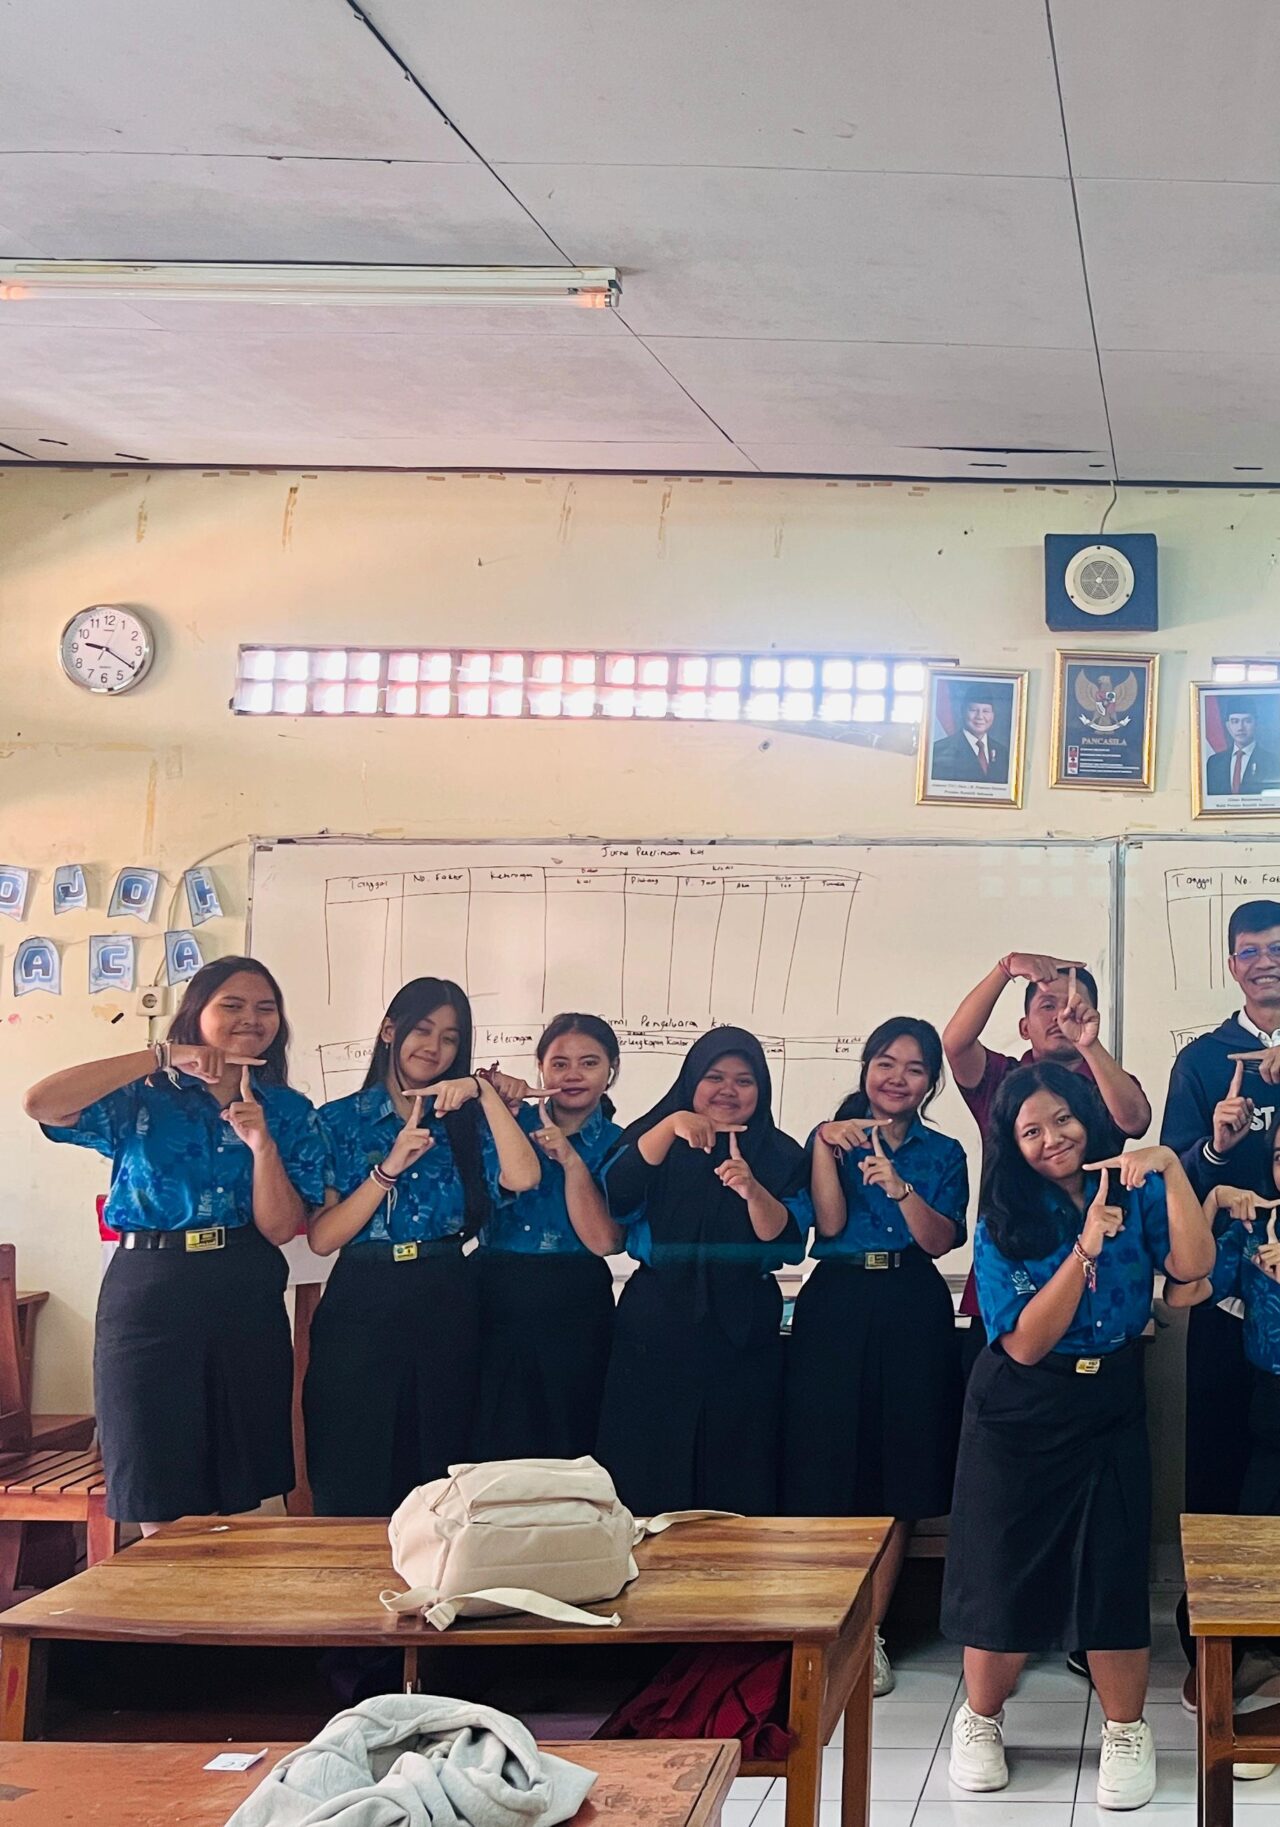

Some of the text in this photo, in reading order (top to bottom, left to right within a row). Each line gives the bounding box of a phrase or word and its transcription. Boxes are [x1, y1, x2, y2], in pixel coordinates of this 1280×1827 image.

[90, 618, 100, 628] 11
[104, 615, 116, 626] 12
[121, 620, 126, 630] 1
[79, 628, 90, 639] 10
[131, 630, 139, 641] 2
[71, 642, 79, 653] 9
[135, 645, 143, 656] 3
[75, 657, 83, 668] 8
[87, 668, 95, 679] 7
[100, 672, 108, 683] 6
[116, 670, 124, 681] 5
[1081, 737, 1127, 746] PANCASILA
